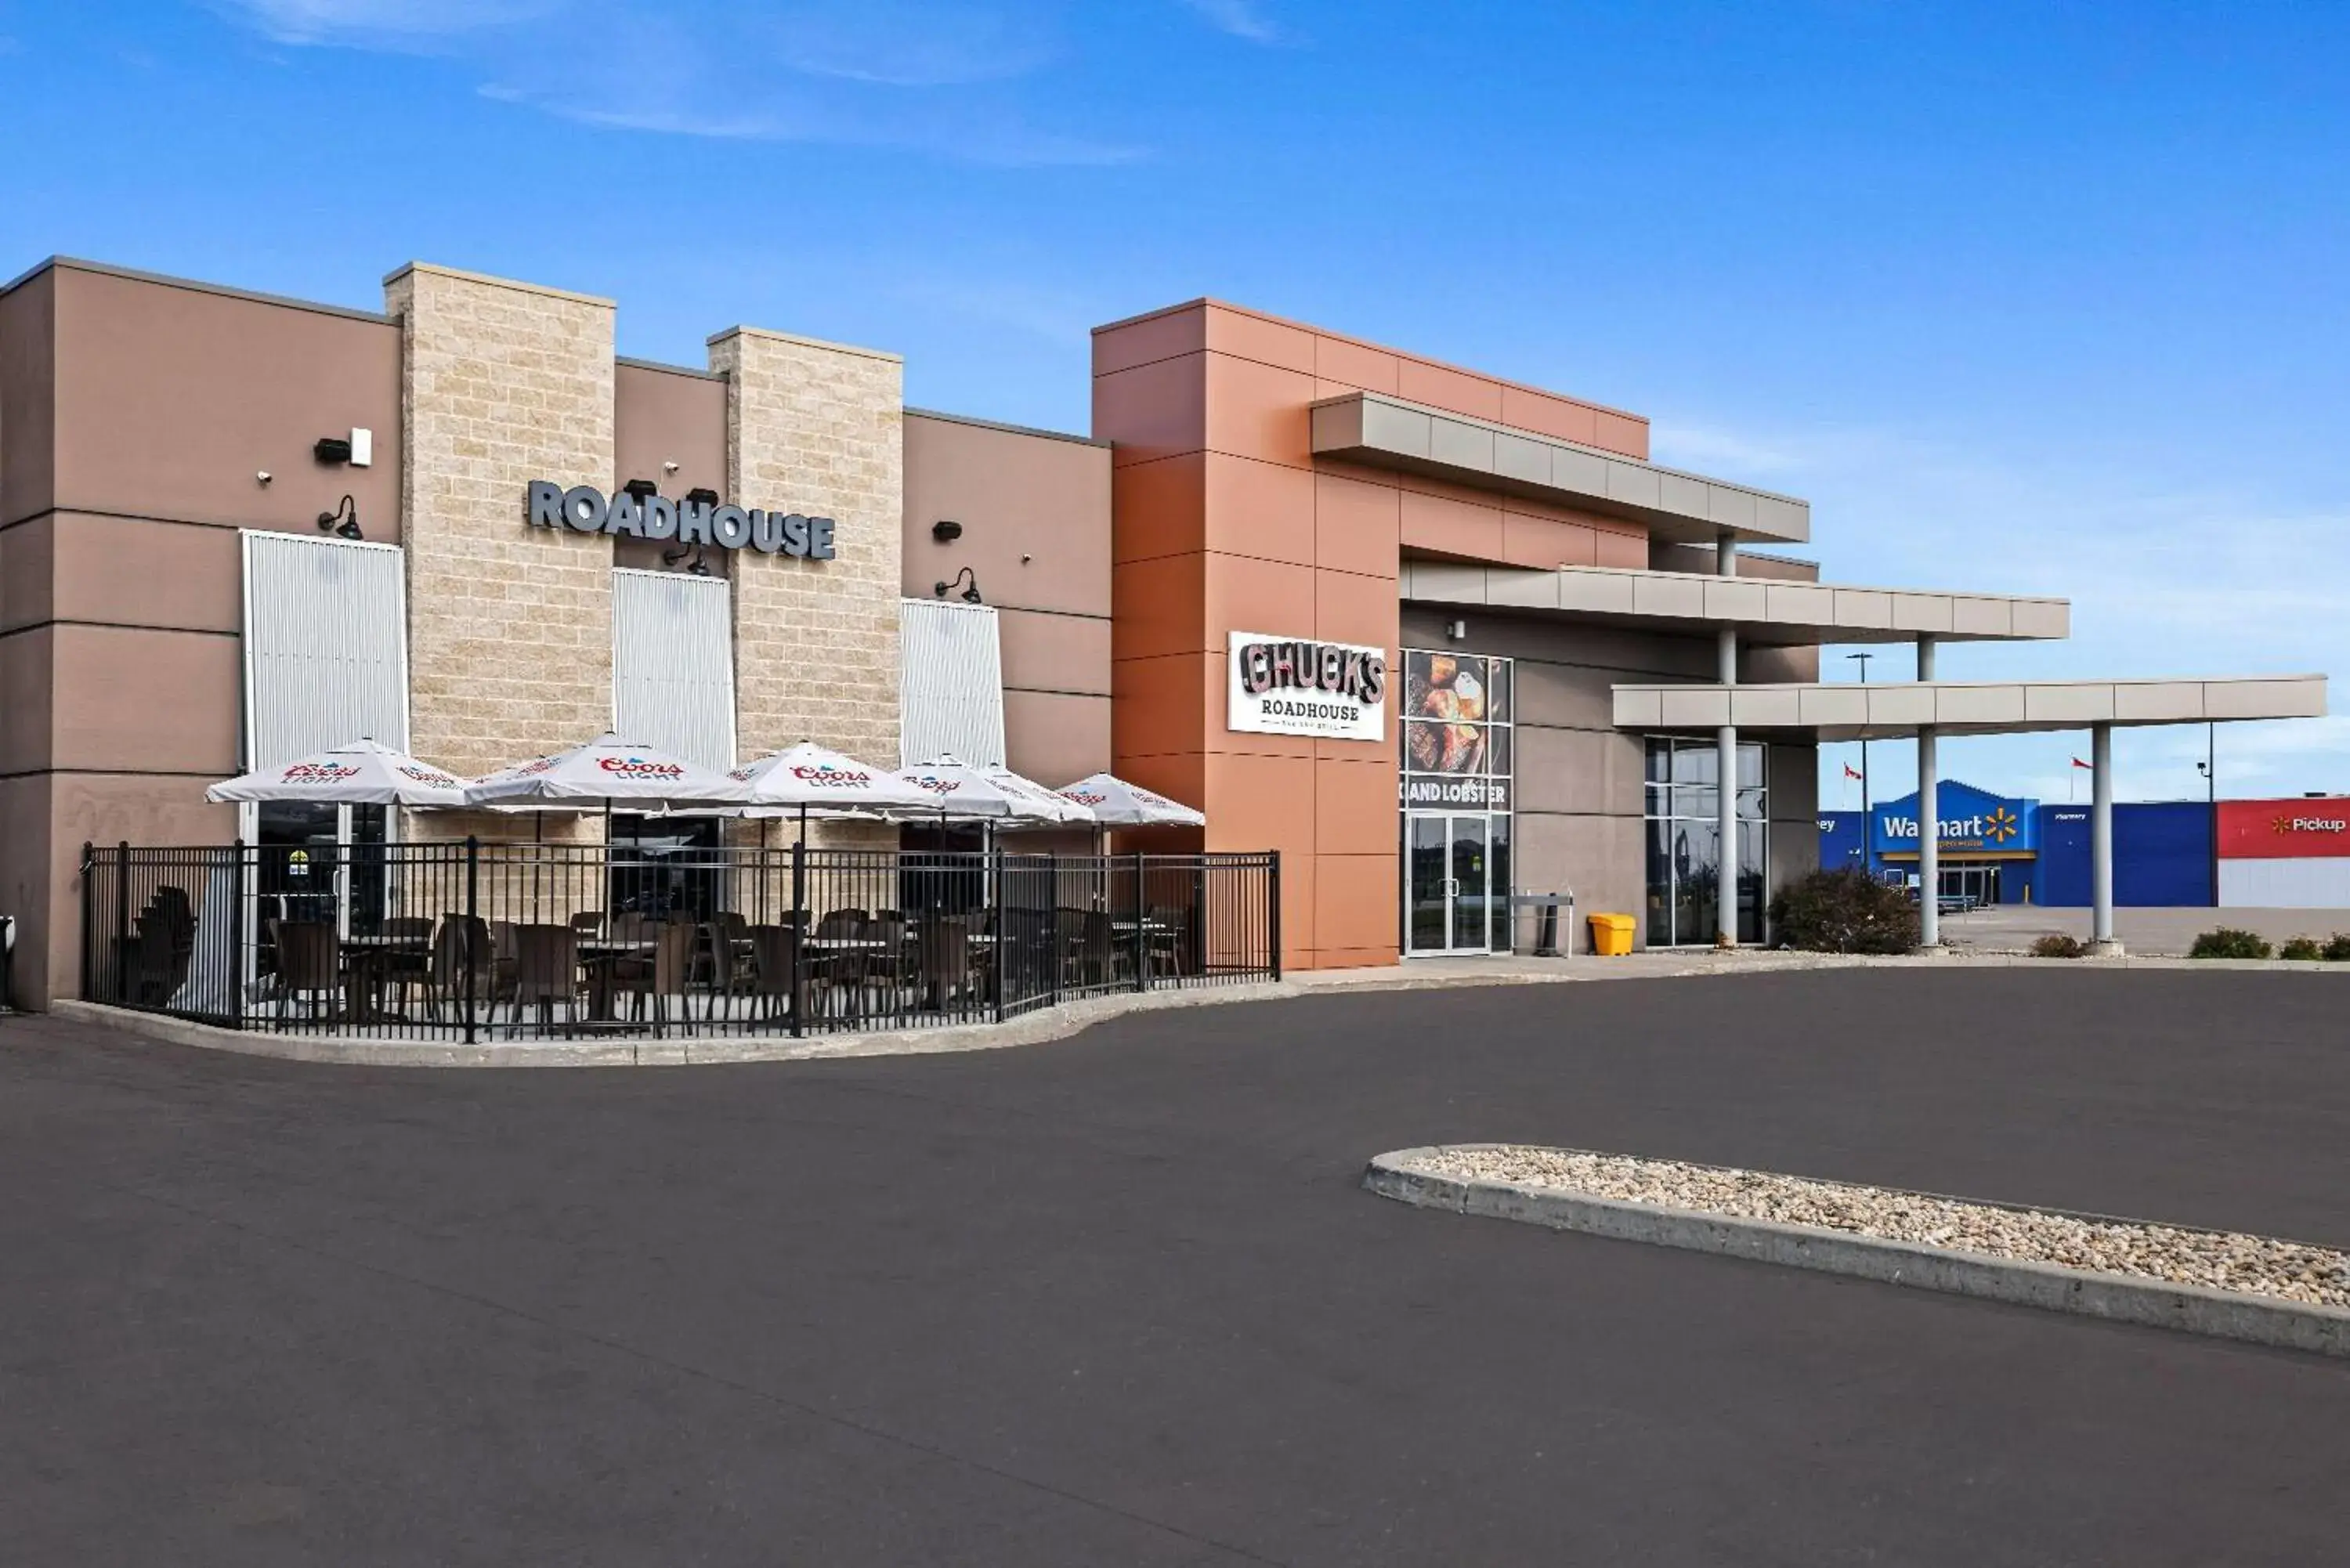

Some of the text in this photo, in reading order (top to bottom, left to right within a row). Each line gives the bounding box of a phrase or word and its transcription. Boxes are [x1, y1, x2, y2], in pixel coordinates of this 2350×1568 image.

[528, 479, 836, 560] ROADHOUSE
[1261, 699, 1359, 721] ROADHOUSE
[595, 757, 684, 774] Coors
[790, 765, 870, 781] Coors
[1409, 782, 1441, 801] AND
[1442, 783, 1505, 803] LOBSTER
[1884, 815, 1982, 837] Wamart
[2293, 817, 2346, 833] Pickup
